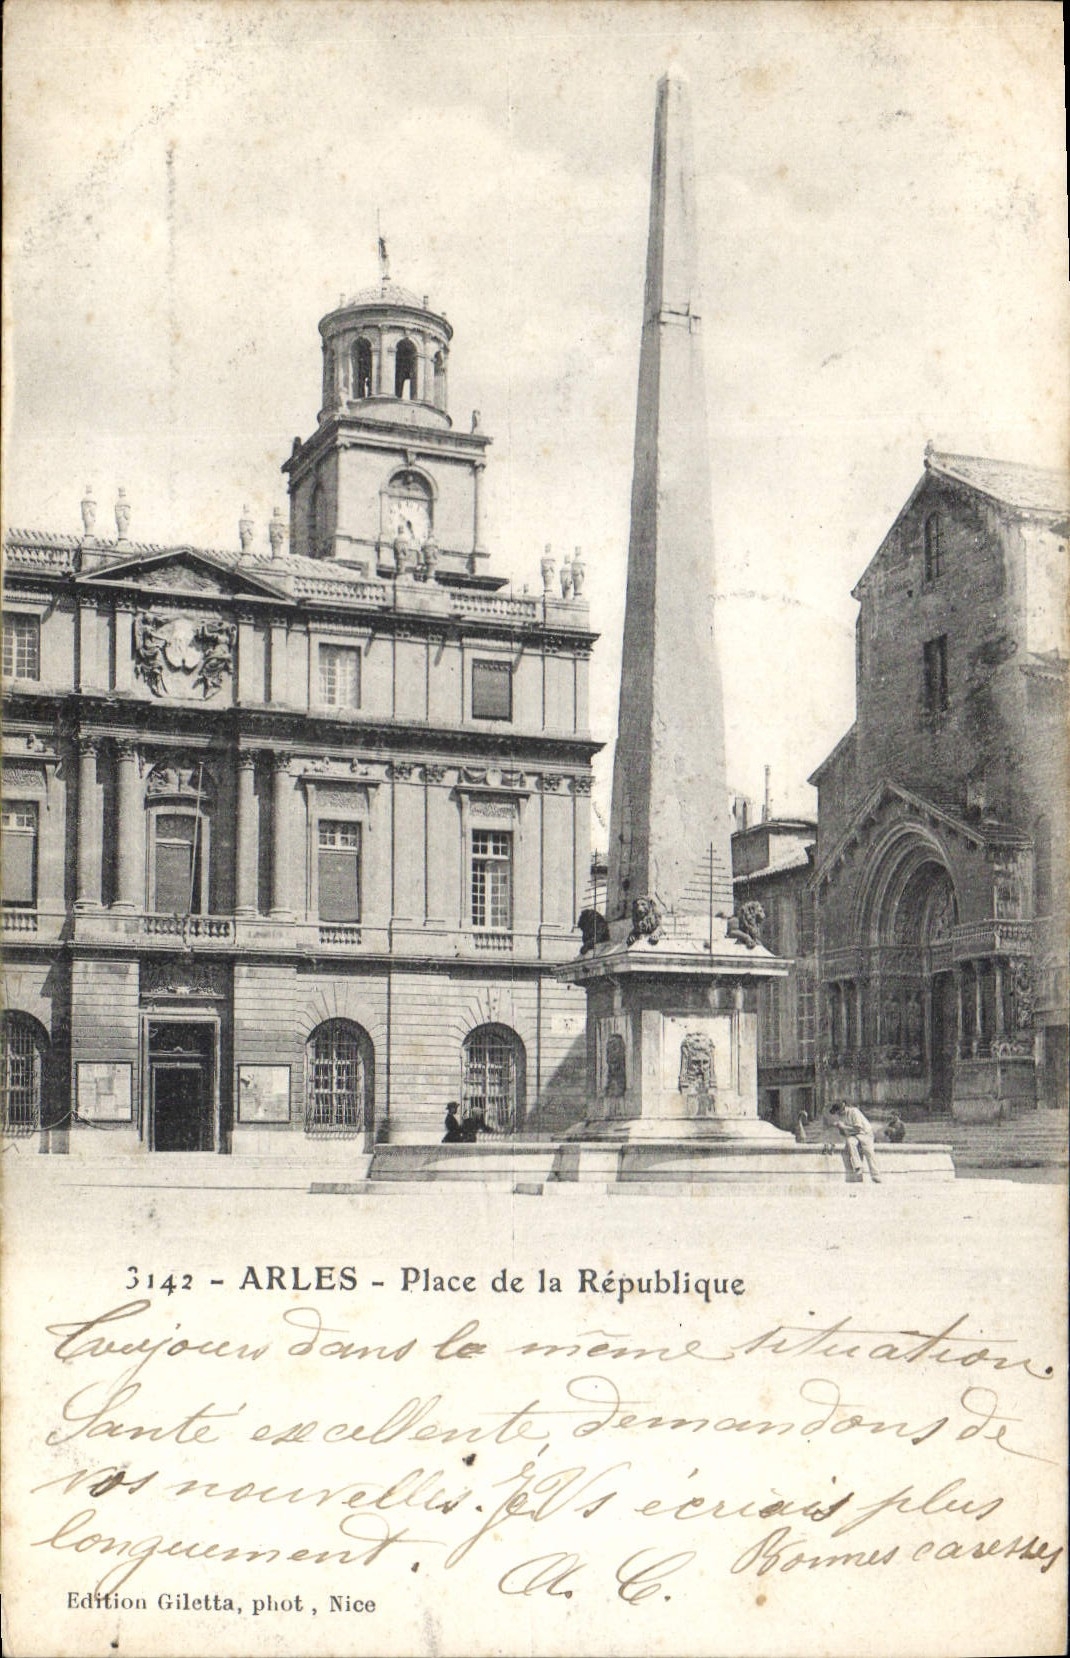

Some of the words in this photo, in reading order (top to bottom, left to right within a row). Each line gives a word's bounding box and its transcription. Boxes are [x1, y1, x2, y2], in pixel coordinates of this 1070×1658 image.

[282, 1307, 417, 1363] dans
[434, 1319, 487, 1360] la
[46, 1381, 248, 1446] Santé
[566, 1374, 950, 1446] demandons
[956, 1386, 1060, 1466] de
[831, 1478, 1006, 1538] plus
